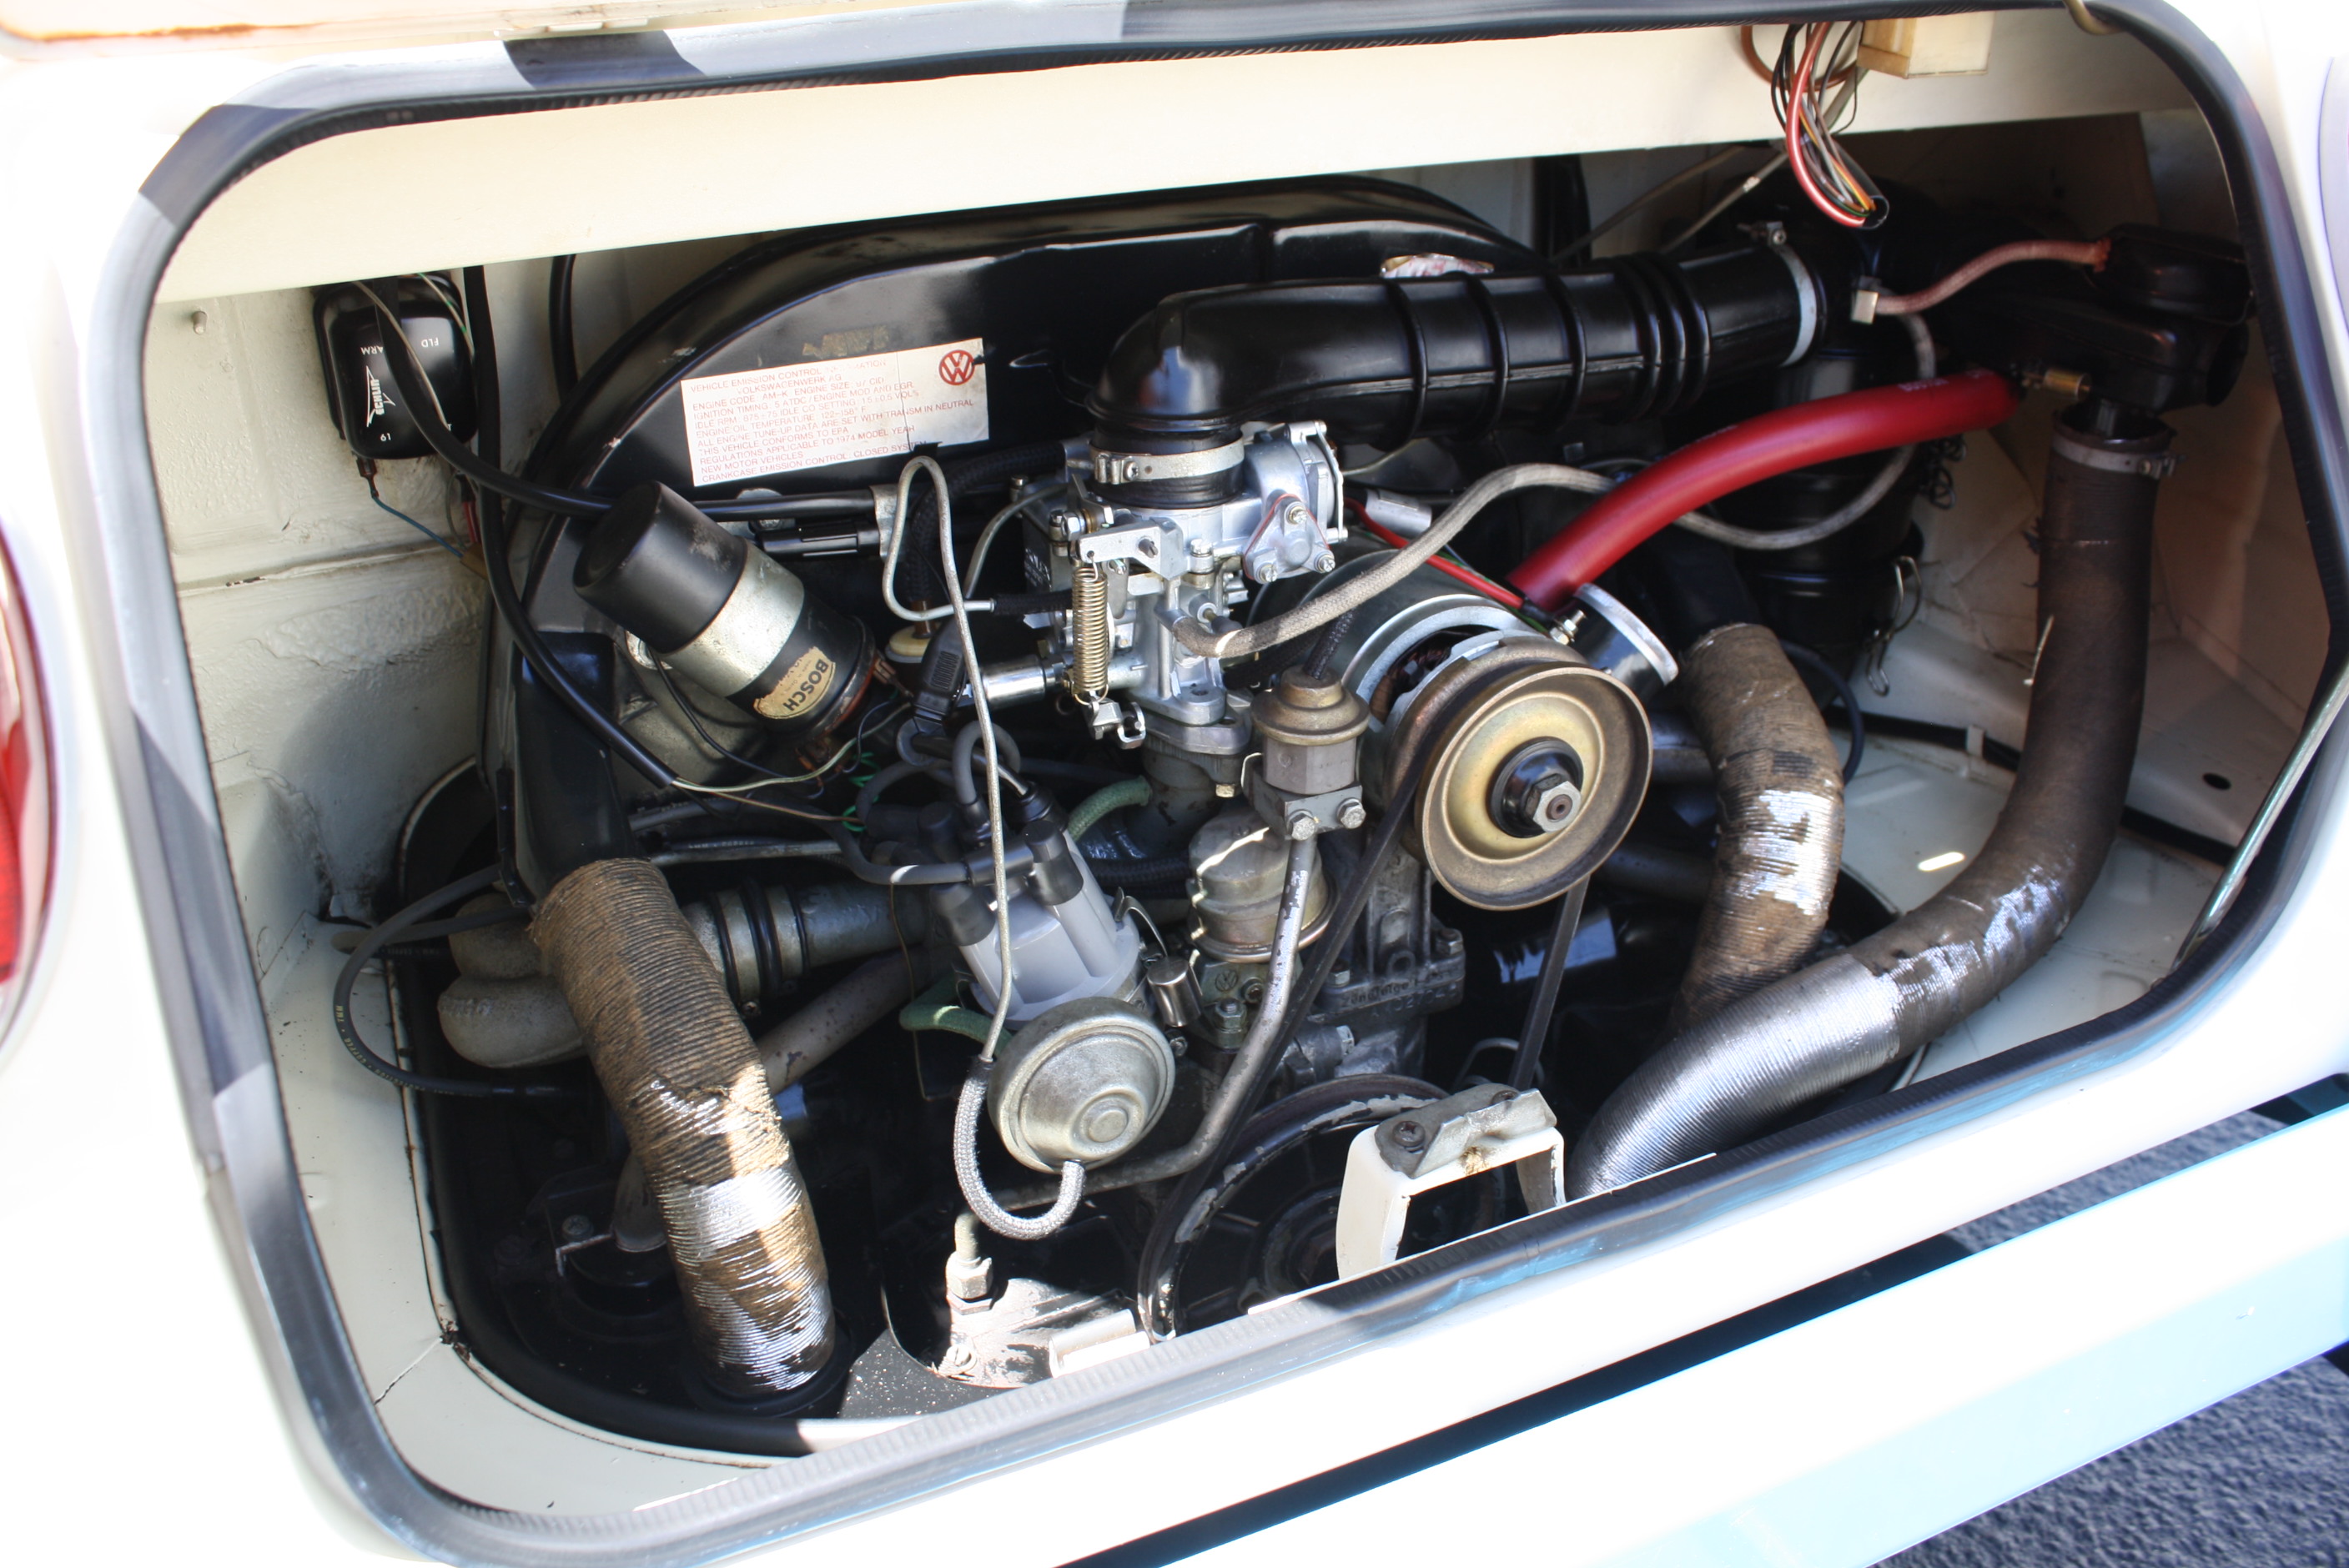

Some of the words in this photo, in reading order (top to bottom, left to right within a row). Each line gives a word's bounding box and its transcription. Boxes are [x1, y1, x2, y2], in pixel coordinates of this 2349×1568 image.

[360, 345, 384, 355] ARM
[421, 337, 440, 348] FLD
[690, 380, 729, 392] VEHICLE
[731, 374, 775, 386] EMISSION
[777, 367, 821, 379] CONTROL
[828, 373, 842, 381] AG
[370, 379, 385, 415] ECHLIN
[692, 399, 727, 410] ENGINE
[794, 384, 827, 396] ENGINE
[869, 376, 883, 384] CID
[693, 407, 733, 420] IGNITION
[782, 396, 807, 406] ATDC
[813, 390, 847, 402] ENGINE
[849, 387, 870, 396] MOD
[873, 384, 891, 393] AND
[893, 381, 913, 390] EGR
[695, 420, 714, 429] IDLE
[780, 406, 799, 416] IDLE
[802, 405, 815, 413] CO
[697, 438, 715, 447] ALL
[717, 432, 750, 445] ENGINE
[753, 426, 792, 439] TUNE-UP
[794, 422, 818, 432] DATA
[821, 419, 837, 429] ARE
[841, 416, 857, 425] SET
[860, 412, 883, 422] WITH
[924, 405, 932, 413] IN
[935, 399, 973, 411] NEUTRAL
[696, 426, 730, 438] ENGINE
[732, 424, 747, 432] OIL
[722, 440, 759, 452] VEHICLE
[762, 432, 813, 446] CONFORMS
[831, 426, 848, 435] EPA
[699, 449, 762, 465] REGULATIONS
[766, 440, 818, 455] APPLICABLE
[836, 435, 855, 444] 1974
[858, 429, 888, 440] MODEL
[891, 425, 914, 435] YEAR
[701, 464, 722, 473] NEW
[724, 458, 757, 470] MOTOR
[760, 451, 803, 464] VEHICLES
[702, 467, 757, 482] CRANKCASE
[760, 460, 802, 473] EMISSION
[853, 446, 888, 458] CLOSED
[782, 658, 829, 711] BOSCH
